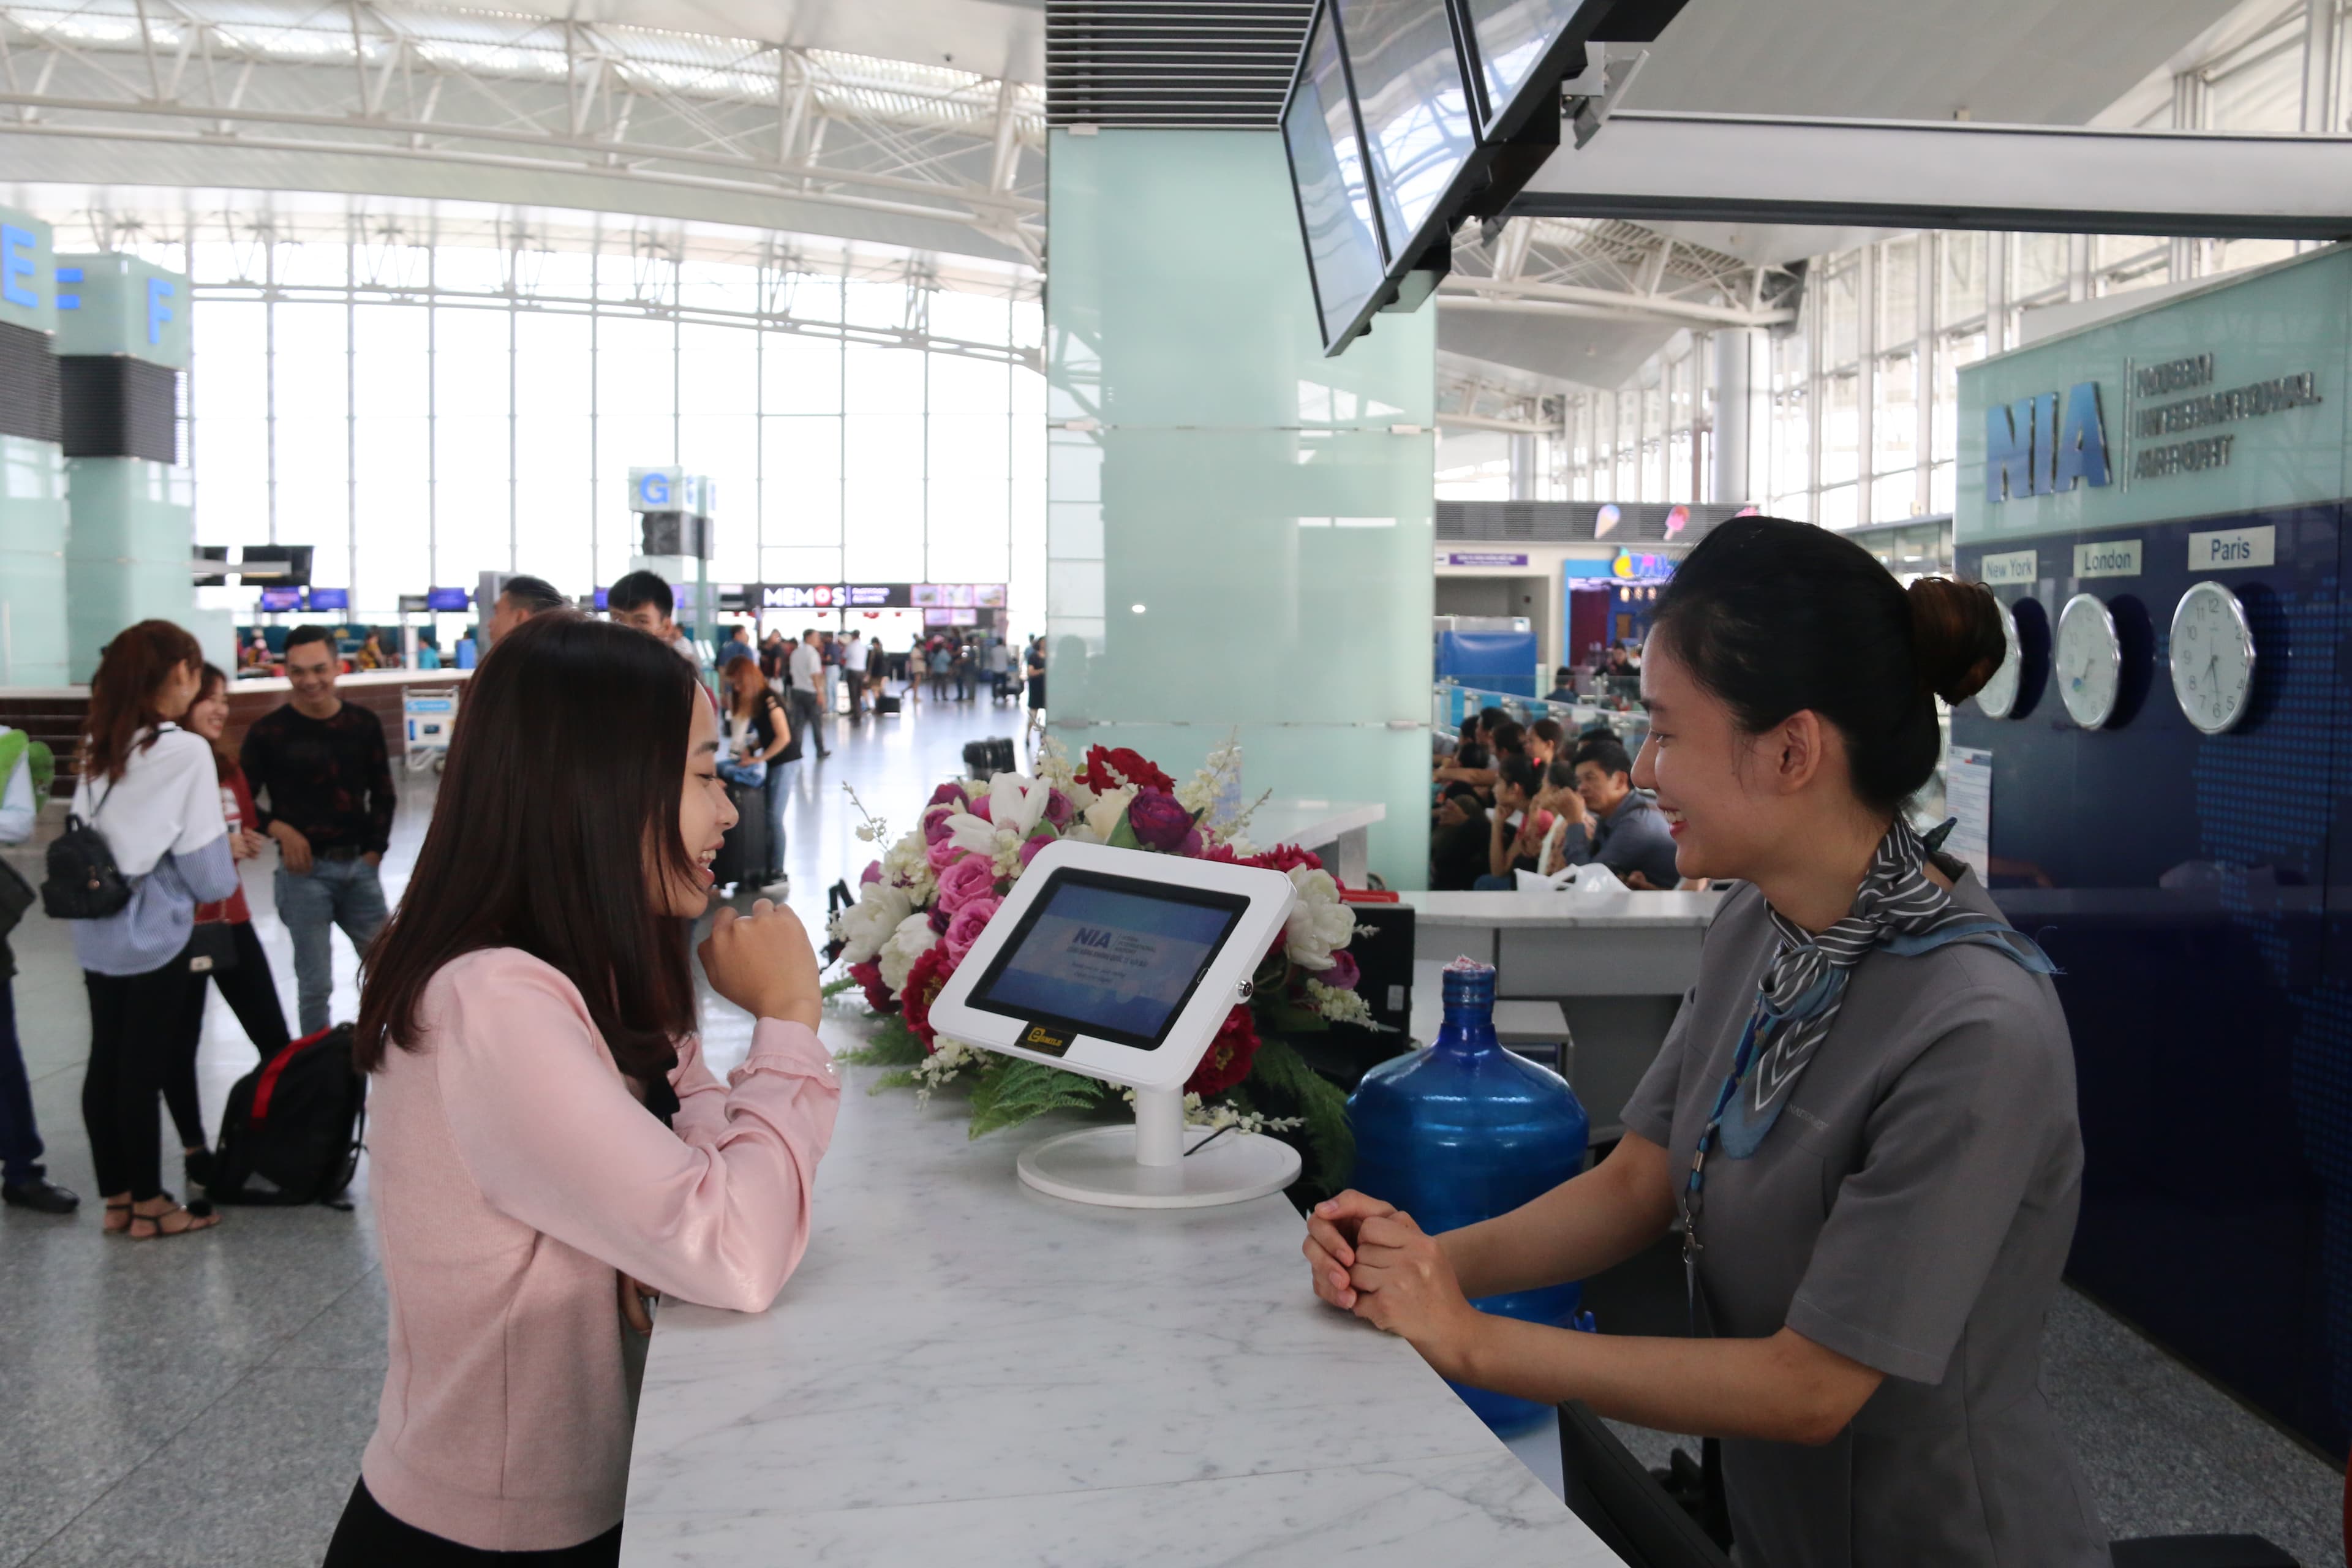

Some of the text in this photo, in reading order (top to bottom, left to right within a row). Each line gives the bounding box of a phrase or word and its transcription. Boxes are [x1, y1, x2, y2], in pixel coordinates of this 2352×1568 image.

[1, 223, 38, 307] E
[148, 277, 174, 345] F
[1986, 381, 2113, 503] NIA
[639, 472, 669, 505] G
[2084, 551, 2132, 571] London
[2211, 537, 2251, 560] Paris
[1986, 557, 2032, 578] New York
[1072, 927, 1112, 949] NIA
